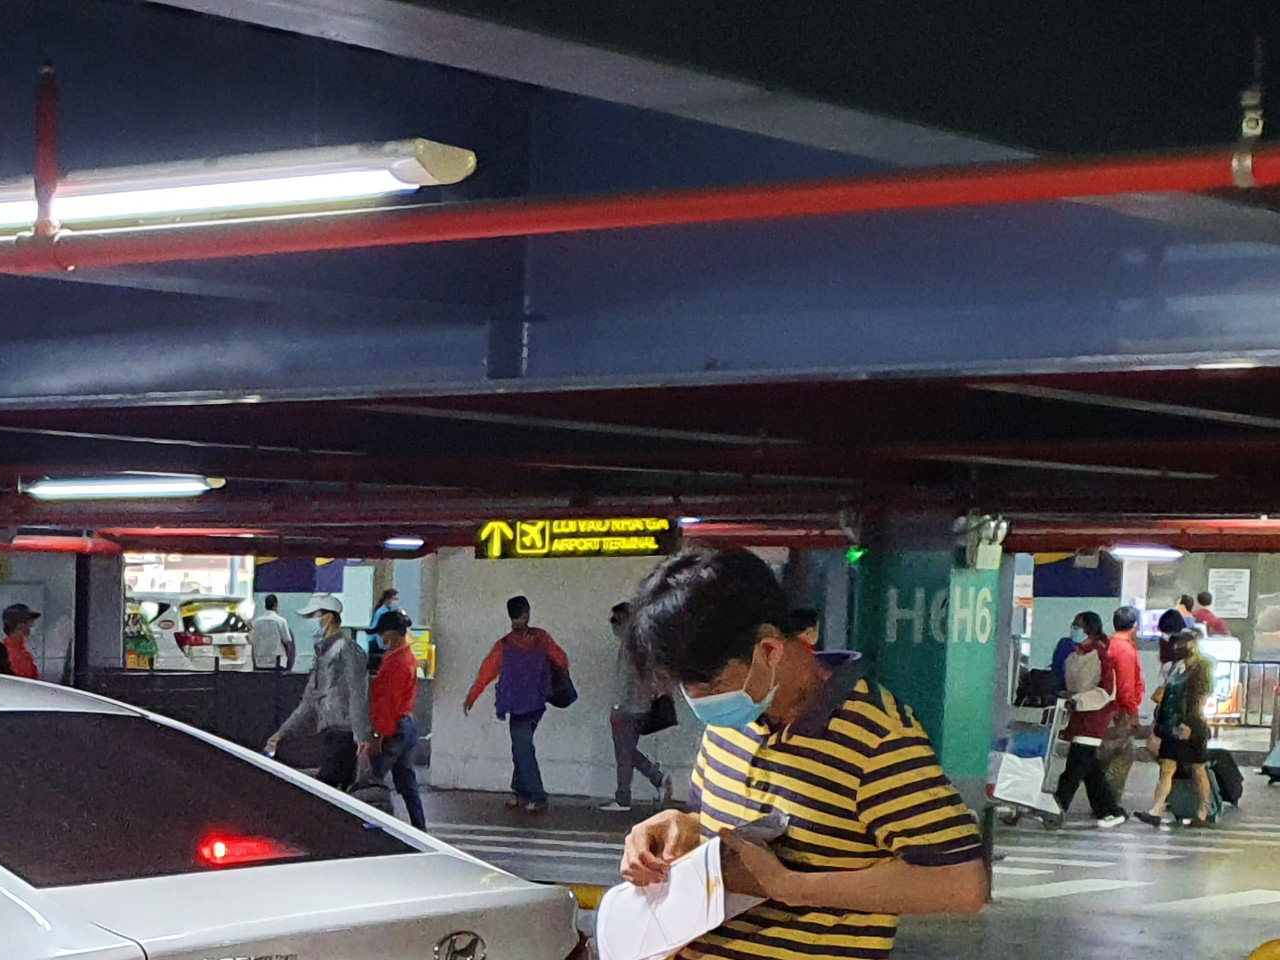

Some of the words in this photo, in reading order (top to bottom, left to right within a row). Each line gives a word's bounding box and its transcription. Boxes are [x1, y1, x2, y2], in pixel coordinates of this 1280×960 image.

[551, 537, 599, 551] AIRPORT
[602, 536, 659, 550] TERMINAL
[952, 586, 992, 643] H6
